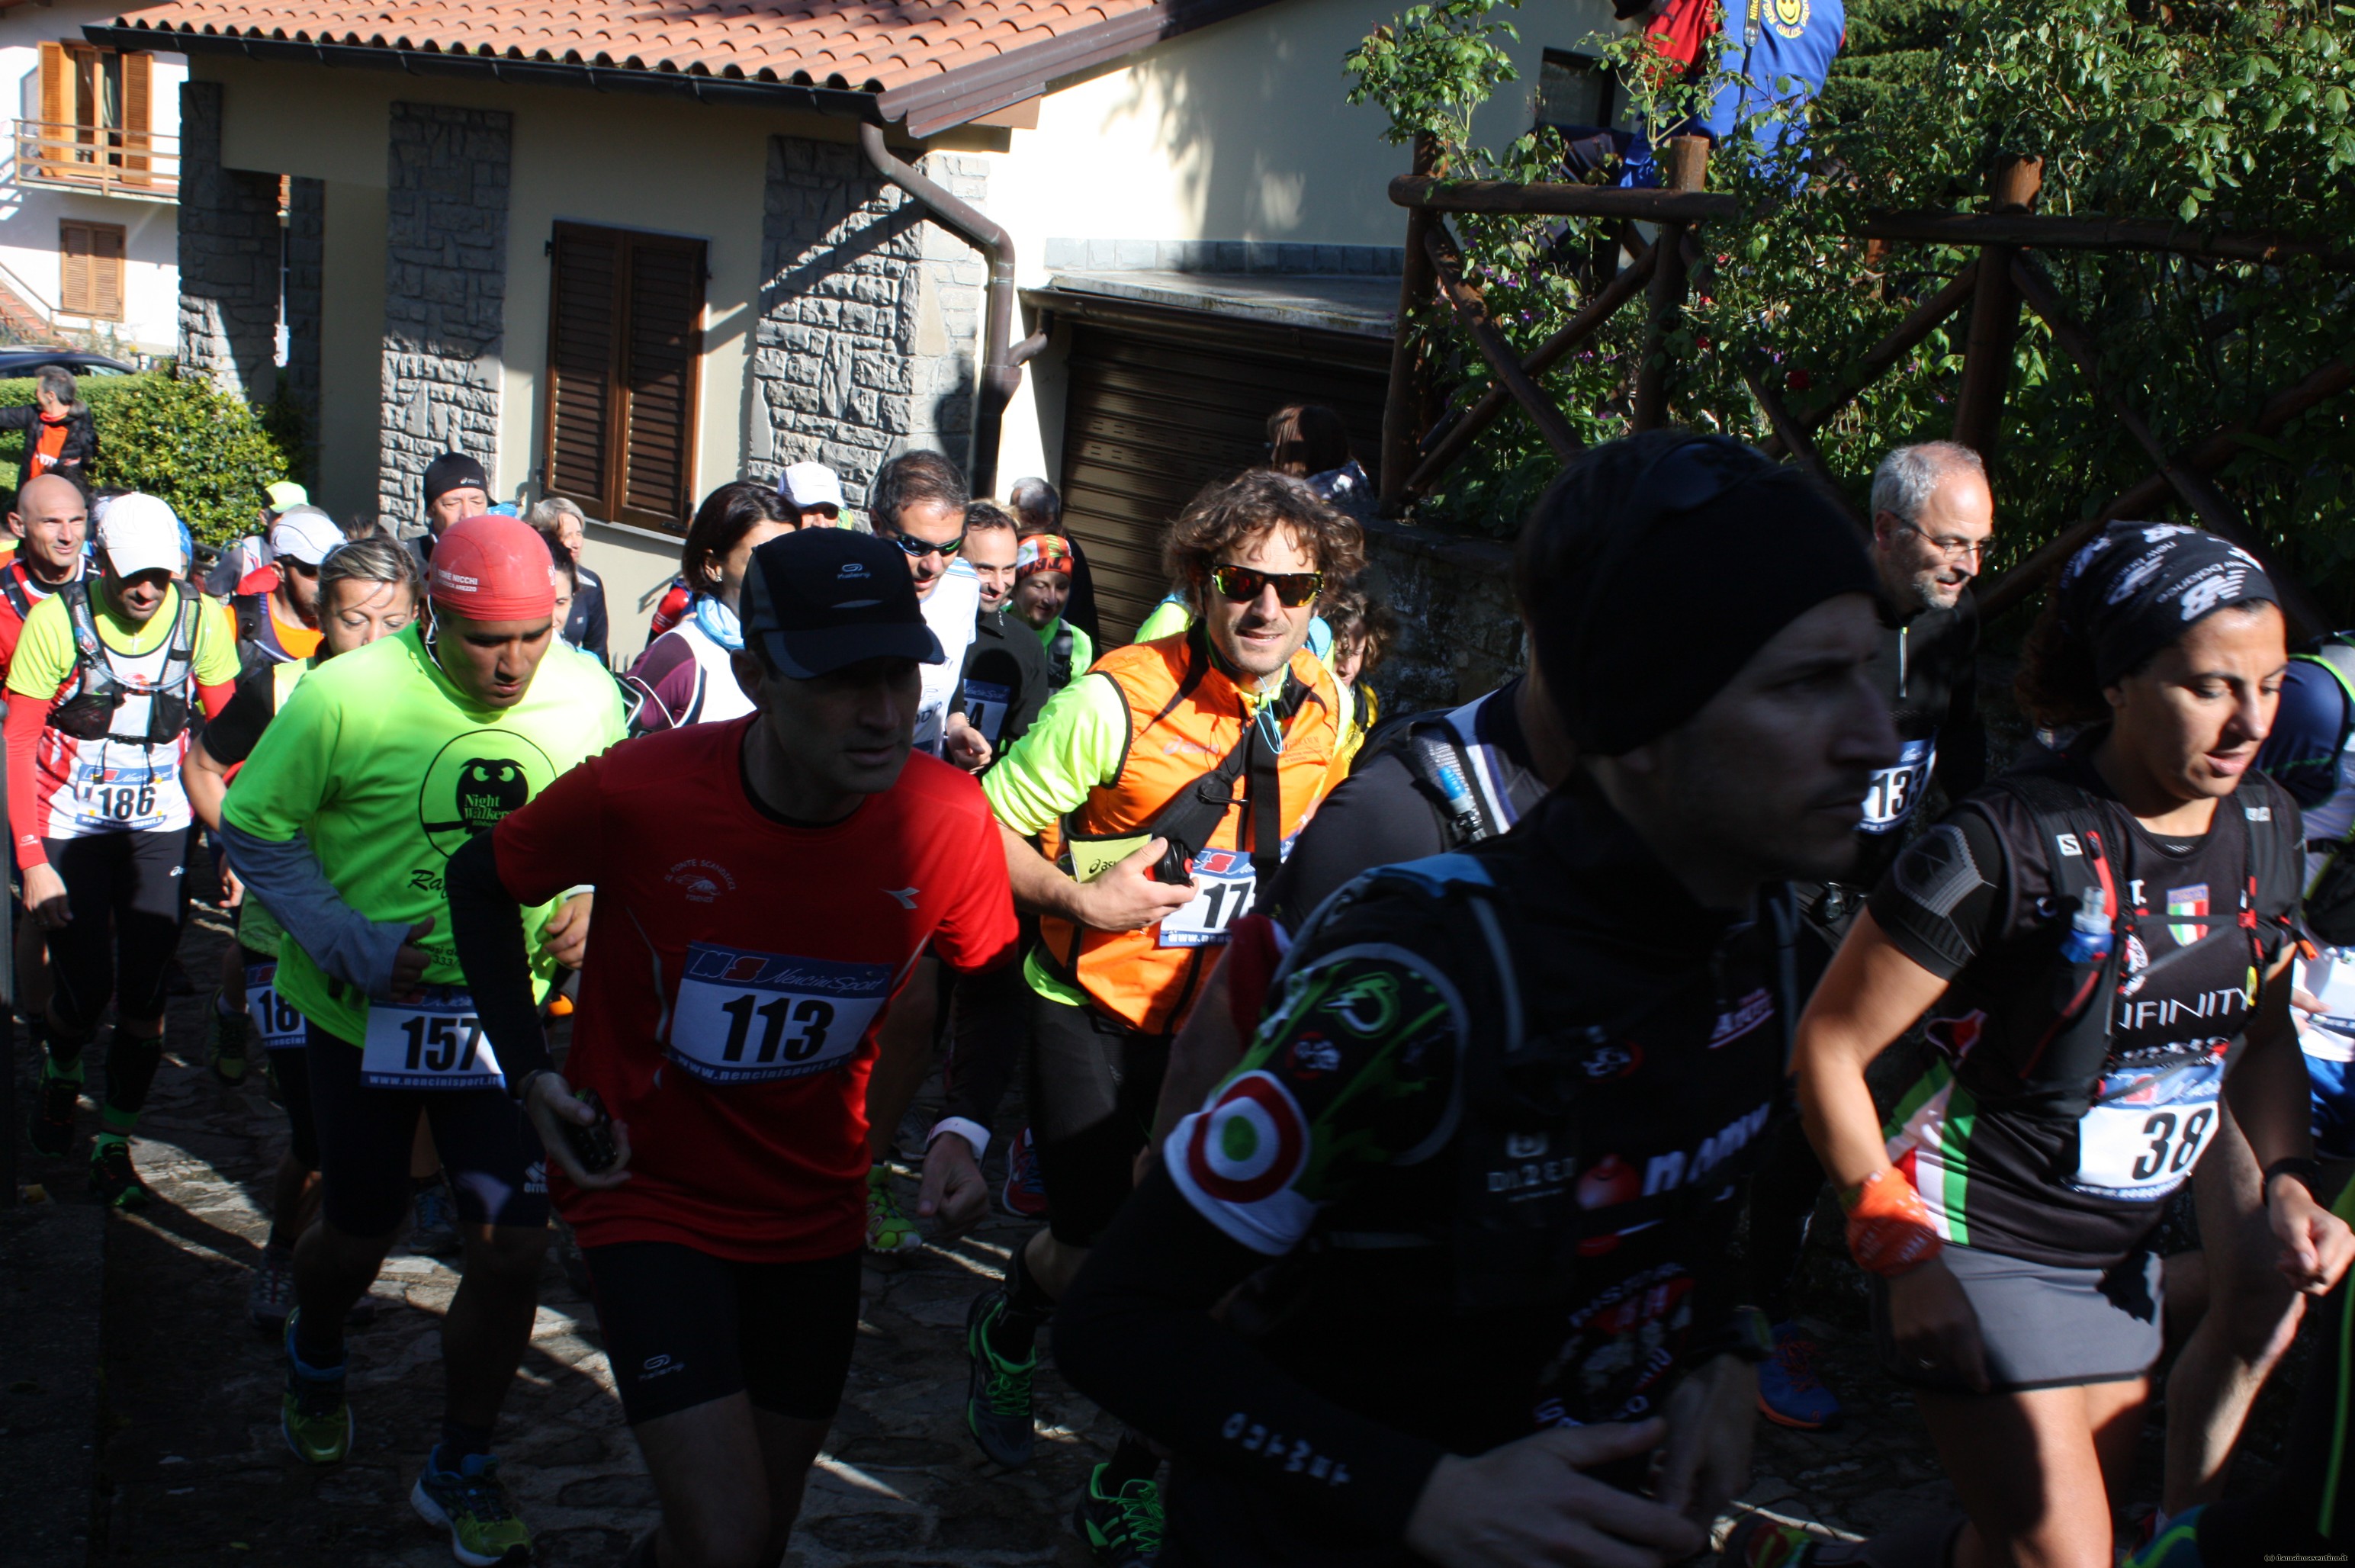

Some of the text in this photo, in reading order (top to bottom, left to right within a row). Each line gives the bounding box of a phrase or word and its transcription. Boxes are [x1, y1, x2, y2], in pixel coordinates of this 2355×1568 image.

[963, 700, 985, 731] 4
[98, 786, 156, 821] 186
[464, 794, 500, 808] Night
[1870, 763, 1928, 818] 133
[464, 808, 513, 821] Walker
[401, 1016, 484, 1072] 157
[722, 994, 834, 1062] 113
[677, 1056, 840, 1081] www.nencinisport.it
[2132, 1108, 2213, 1180] 38
